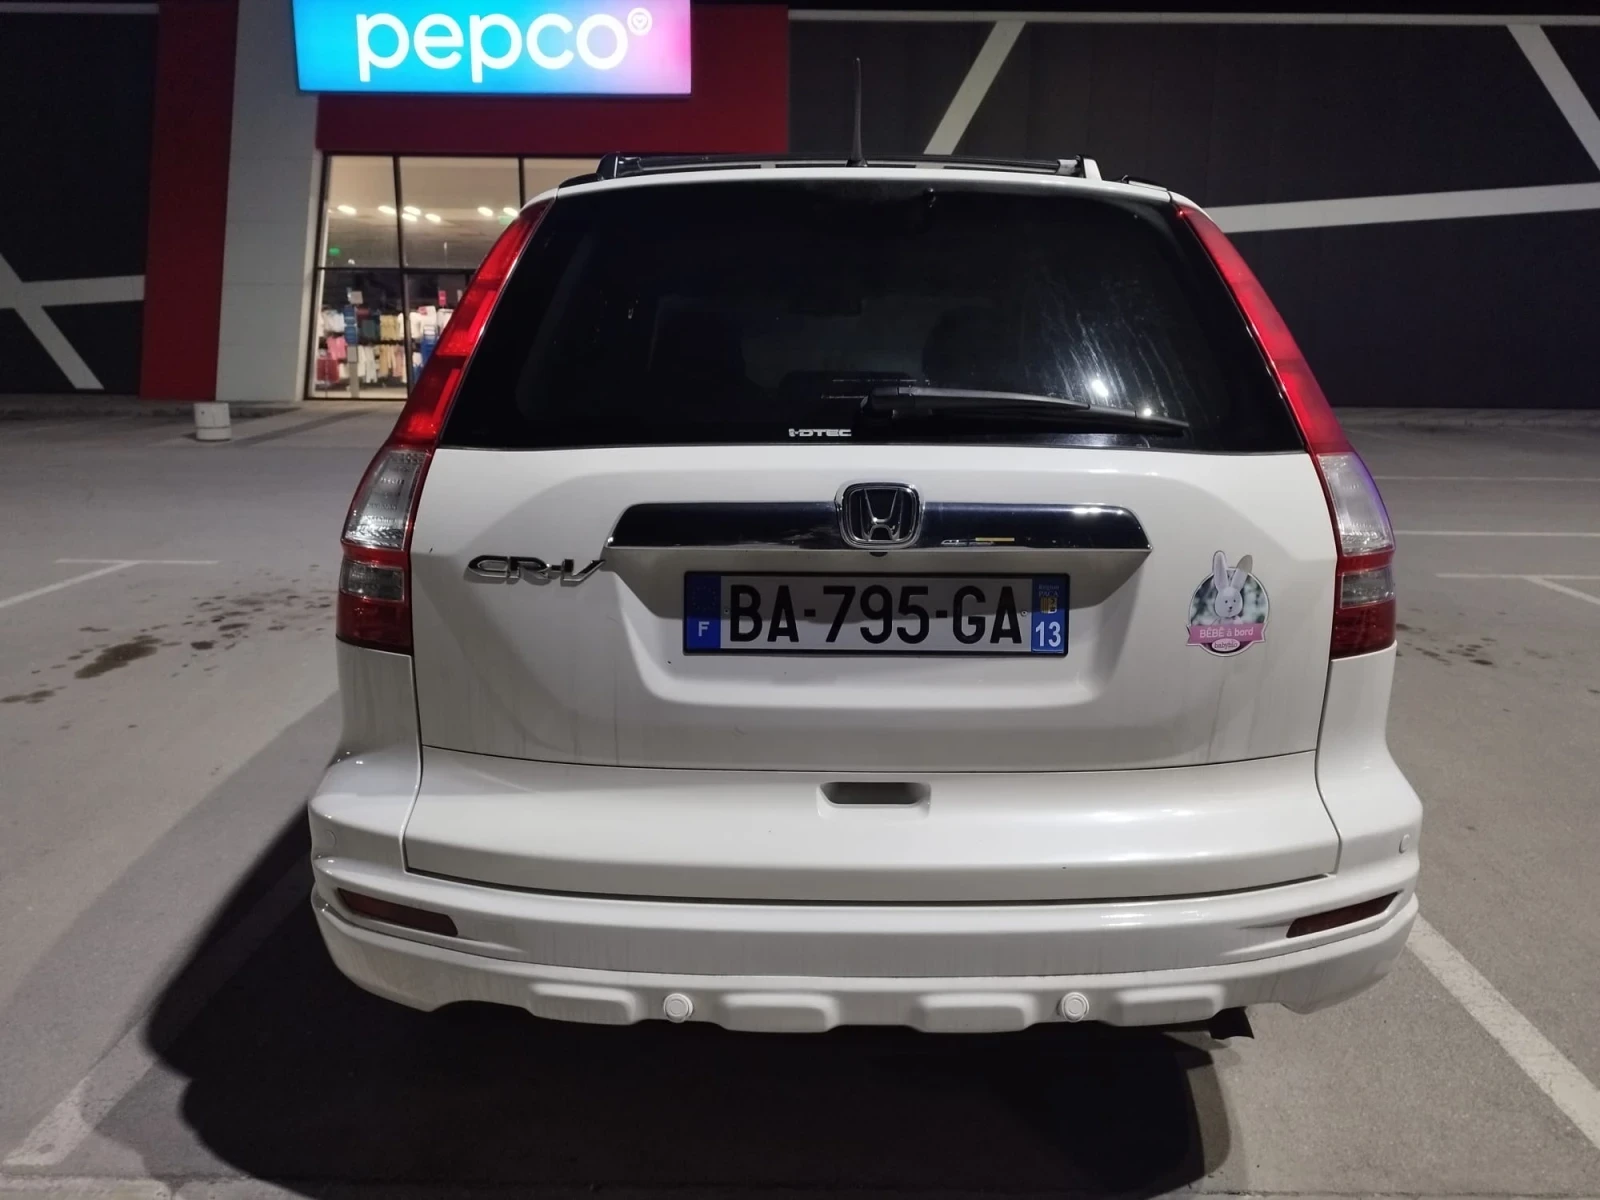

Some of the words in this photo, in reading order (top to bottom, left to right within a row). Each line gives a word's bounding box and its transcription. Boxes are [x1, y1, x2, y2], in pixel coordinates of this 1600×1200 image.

[356, 12, 629, 83] pepco
[467, 554, 606, 582] CR-V
[729, 584, 1023, 644] BA-795-GA
[698, 621, 710, 637] F
[1035, 621, 1062, 647] 13
[1234, 626, 1254, 637] bord
